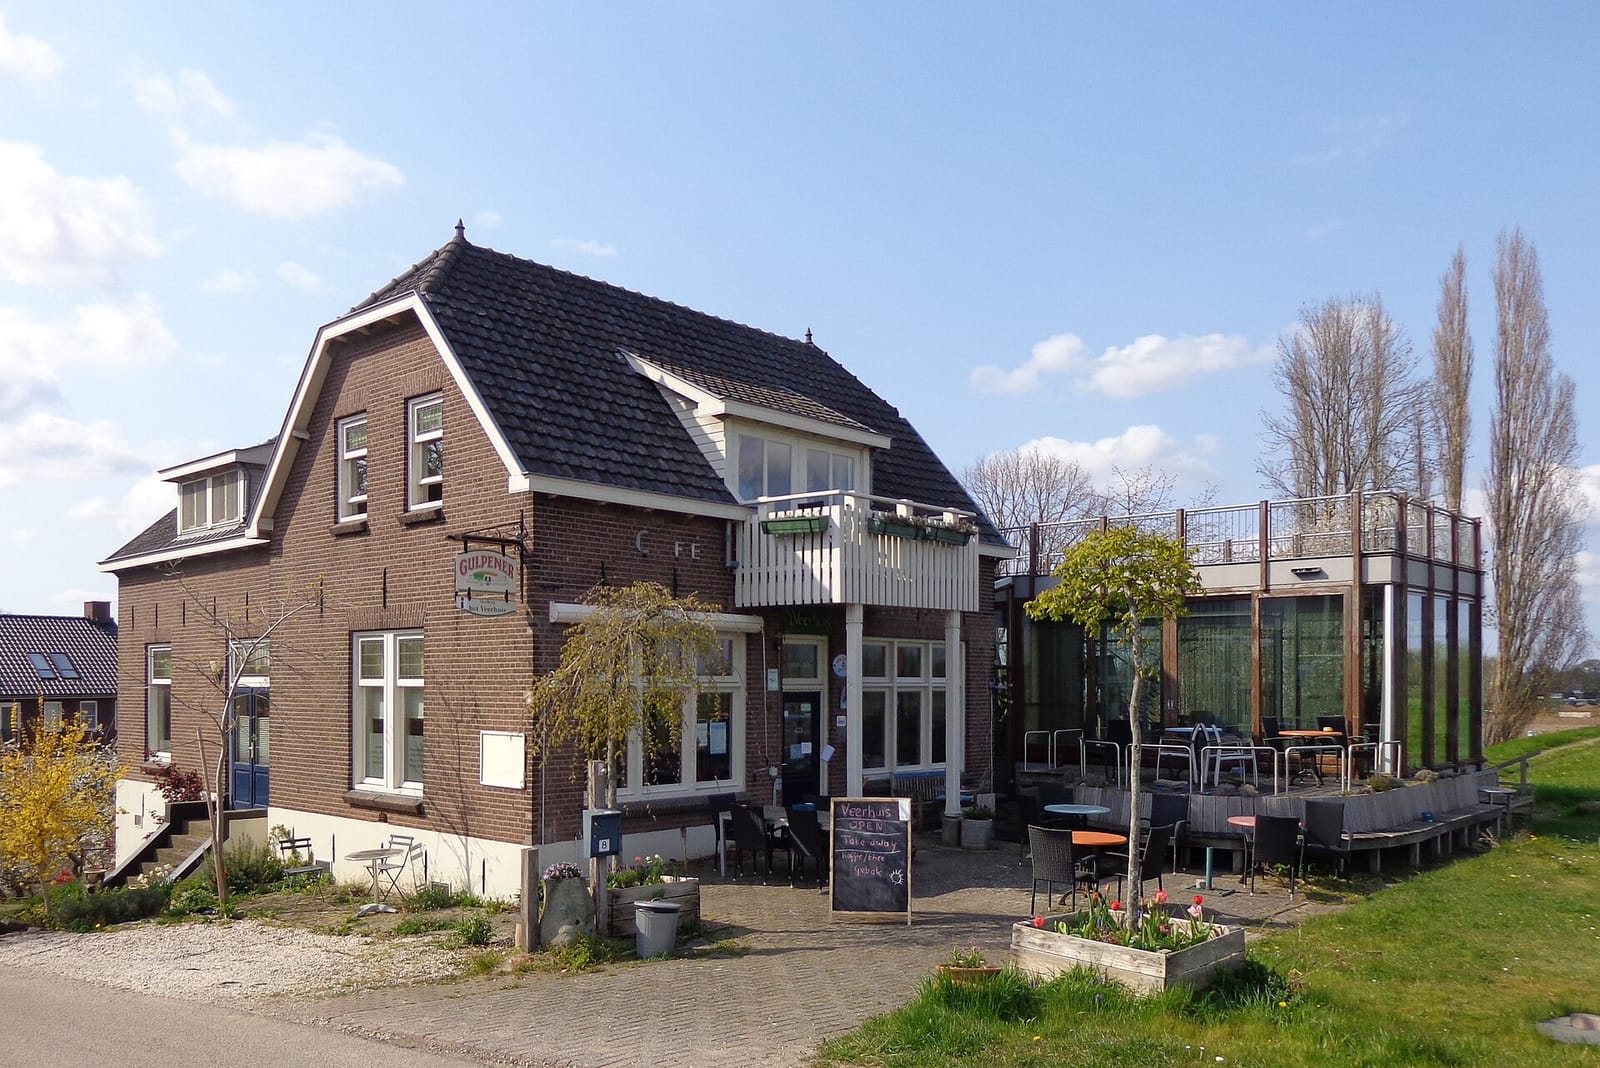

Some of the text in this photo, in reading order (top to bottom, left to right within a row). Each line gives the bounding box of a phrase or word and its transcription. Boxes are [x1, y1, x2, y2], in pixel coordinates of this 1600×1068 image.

[460, 555, 514, 579] GULPENER
[841, 803, 892, 818] Veerhuis
[849, 821, 883, 831] OPEN
[602, 841, 607, 849] 8
[841, 834, 897, 853] Take away
